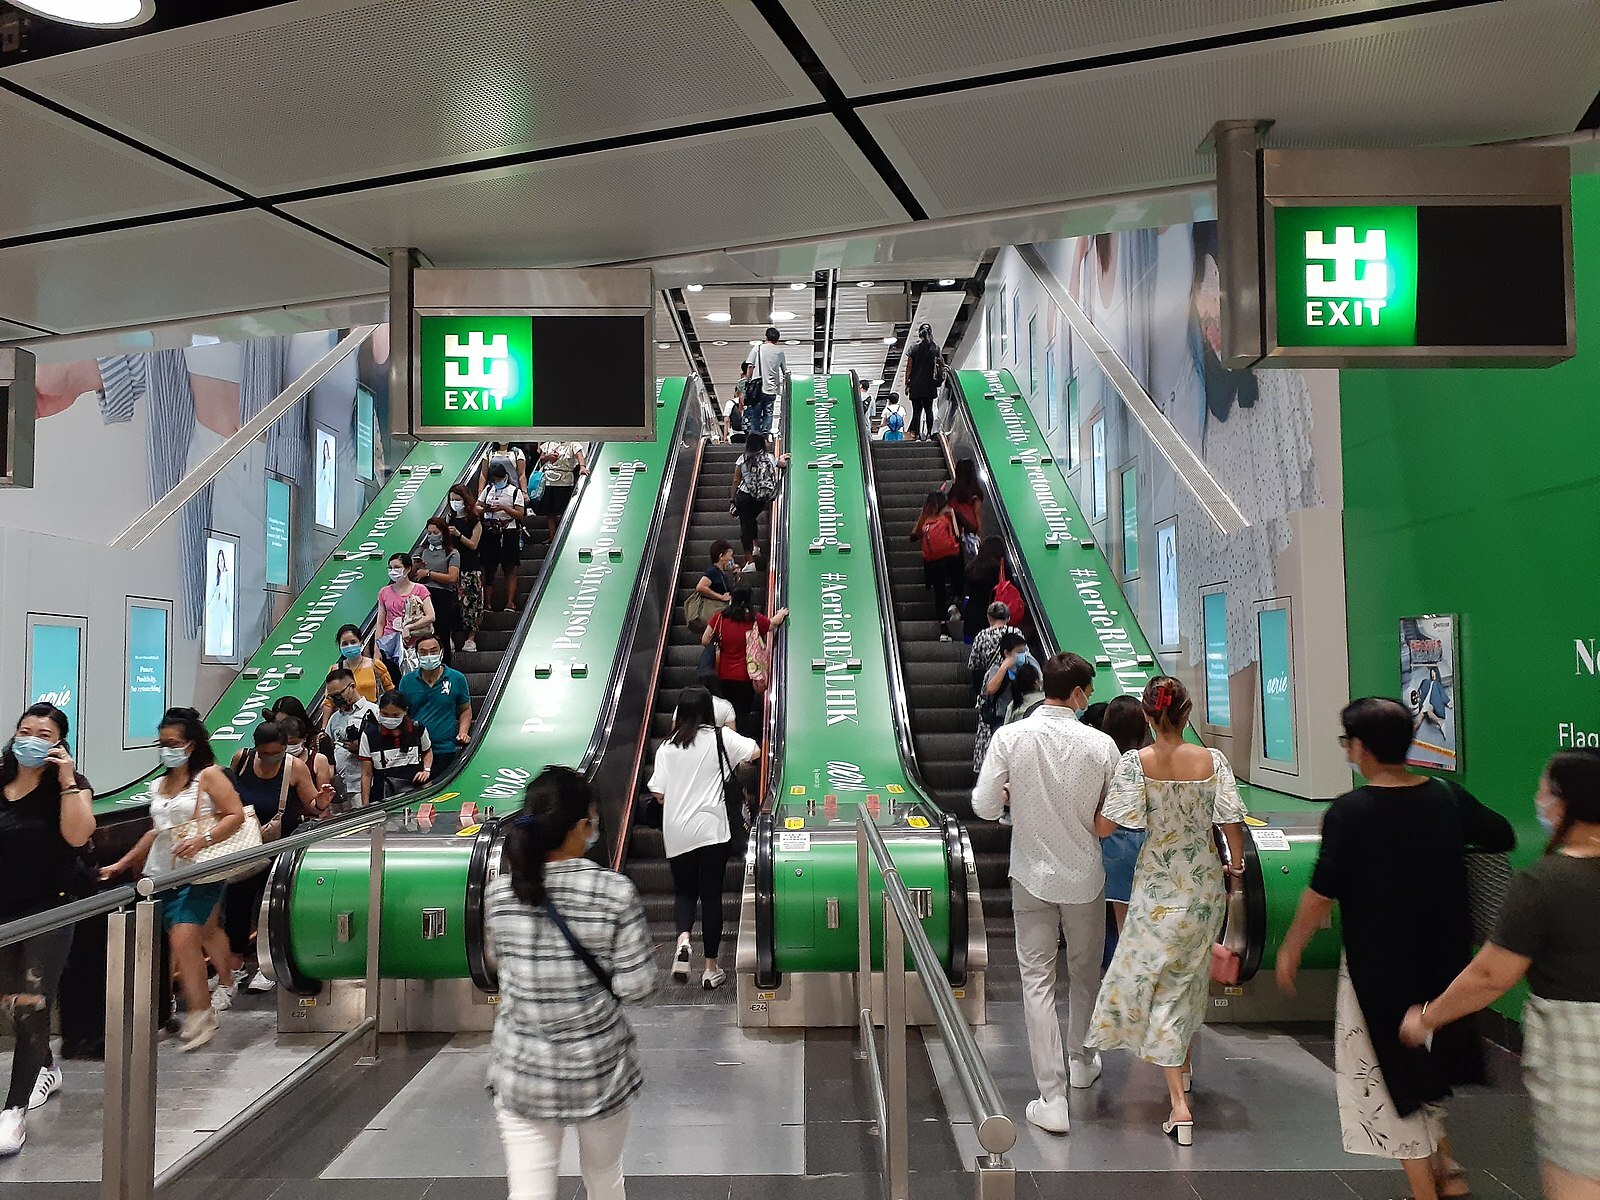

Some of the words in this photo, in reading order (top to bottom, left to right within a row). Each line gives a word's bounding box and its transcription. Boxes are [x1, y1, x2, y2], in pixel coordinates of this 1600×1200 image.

[1305, 300, 1388, 327] EXIT
[444, 390, 508, 411] EXIT
[809, 402, 837, 450] Positivity.
[993, 396, 1031, 445] Positivity.
[1015, 447, 1040, 463] No
[815, 453, 838, 469] No
[208, 663, 293, 741] Power.
[270, 563, 366, 657] Positivity.
[343, 541, 380, 561] No
[366, 462, 437, 538] retouching.
[550, 560, 613, 650] Positivity.
[820, 572, 859, 727] #AerieREALHK
[1573, 638, 1600, 675] N
